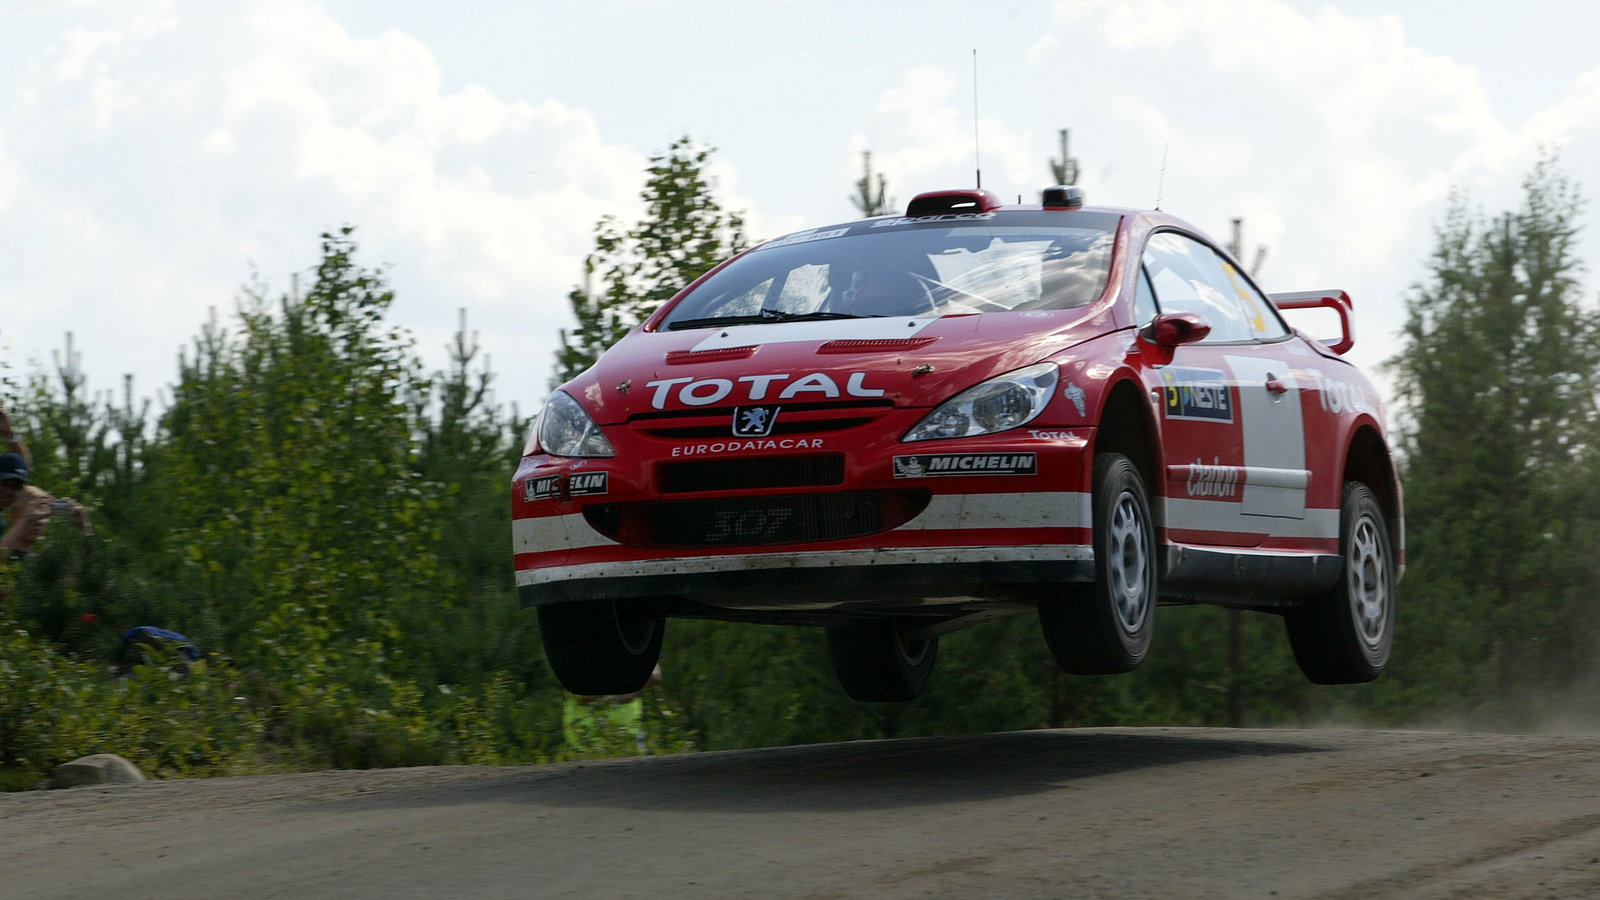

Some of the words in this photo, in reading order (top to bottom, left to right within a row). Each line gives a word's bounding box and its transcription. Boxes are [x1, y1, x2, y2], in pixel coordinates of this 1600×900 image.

[646, 372, 885, 410] TOTAL
[1190, 384, 1226, 410] NESTE
[1028, 430, 1080, 440] TOTAL
[672, 439, 824, 457] EURODATACAR
[929, 455, 1033, 470] MICHELIN
[536, 474, 605, 493] MICELIN
[704, 509, 793, 541] 307
